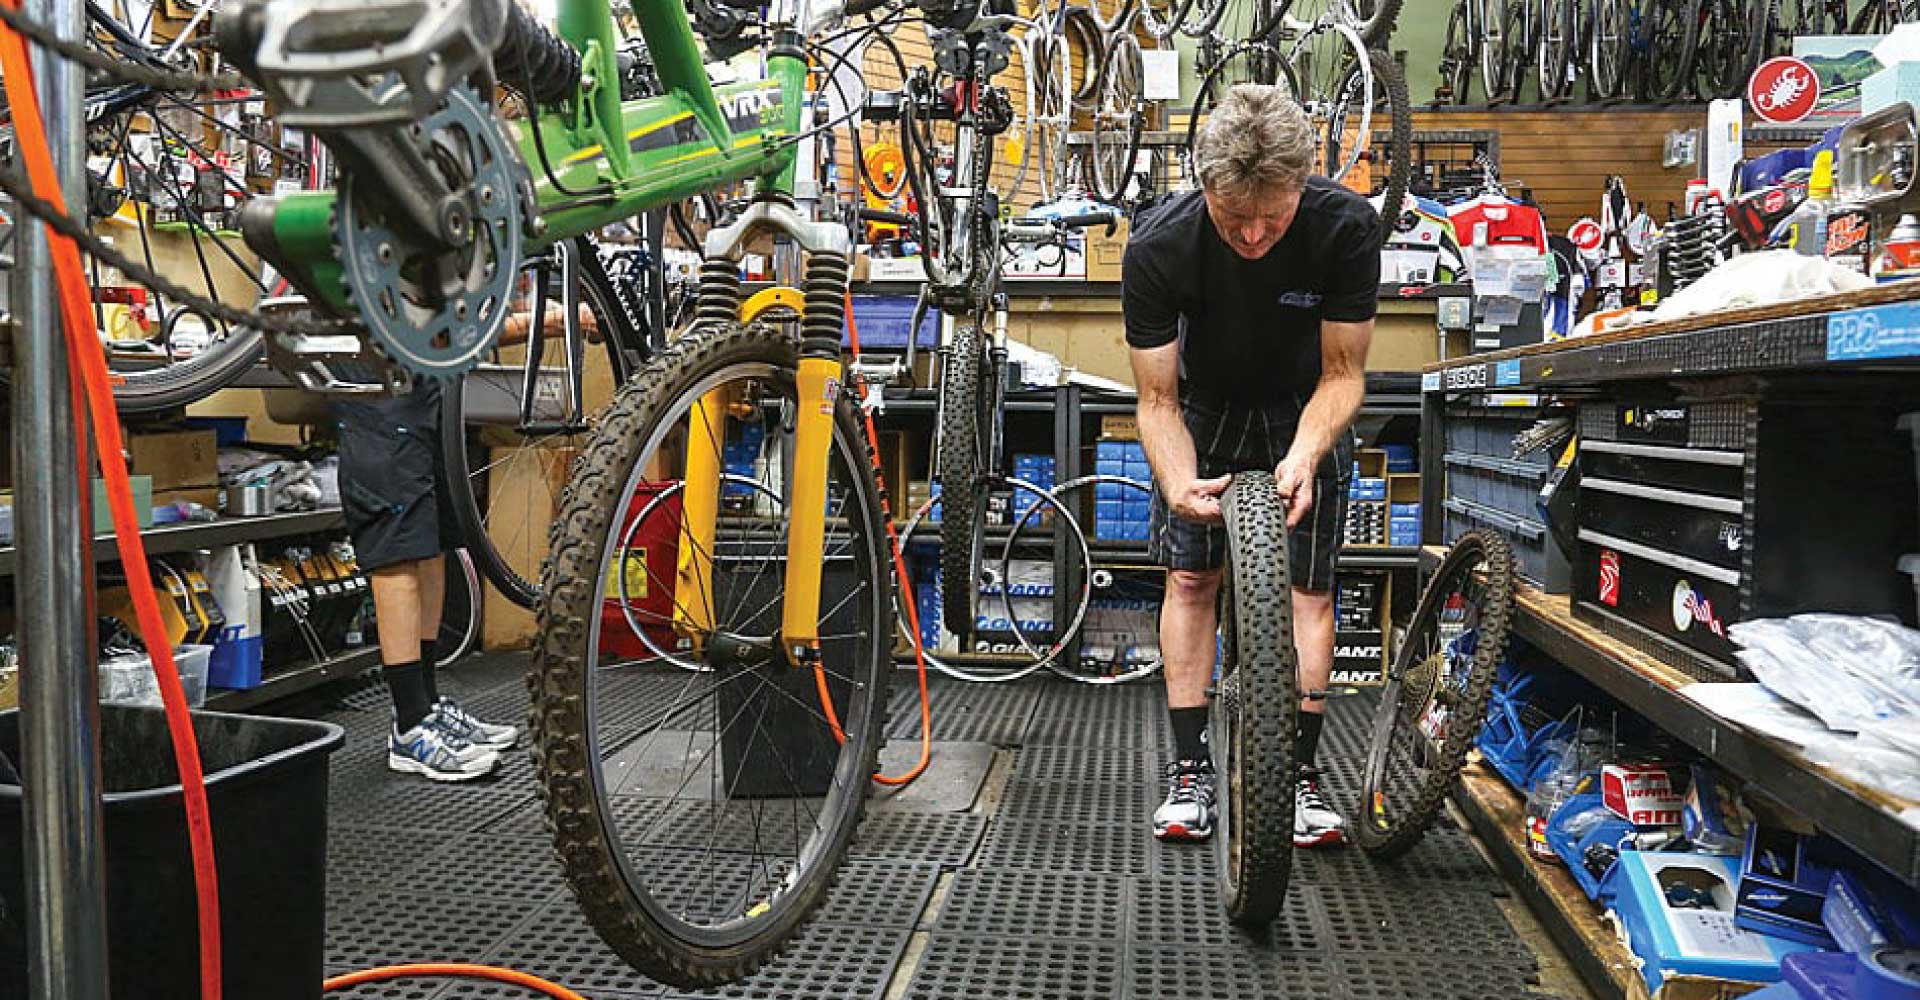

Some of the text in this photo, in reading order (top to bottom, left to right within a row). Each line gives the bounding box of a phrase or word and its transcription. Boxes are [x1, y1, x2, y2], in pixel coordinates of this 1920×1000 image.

[1827, 312, 1879, 354] PRO
[1333, 646, 1382, 657] IANT
[1329, 671, 1381, 682] IANT
